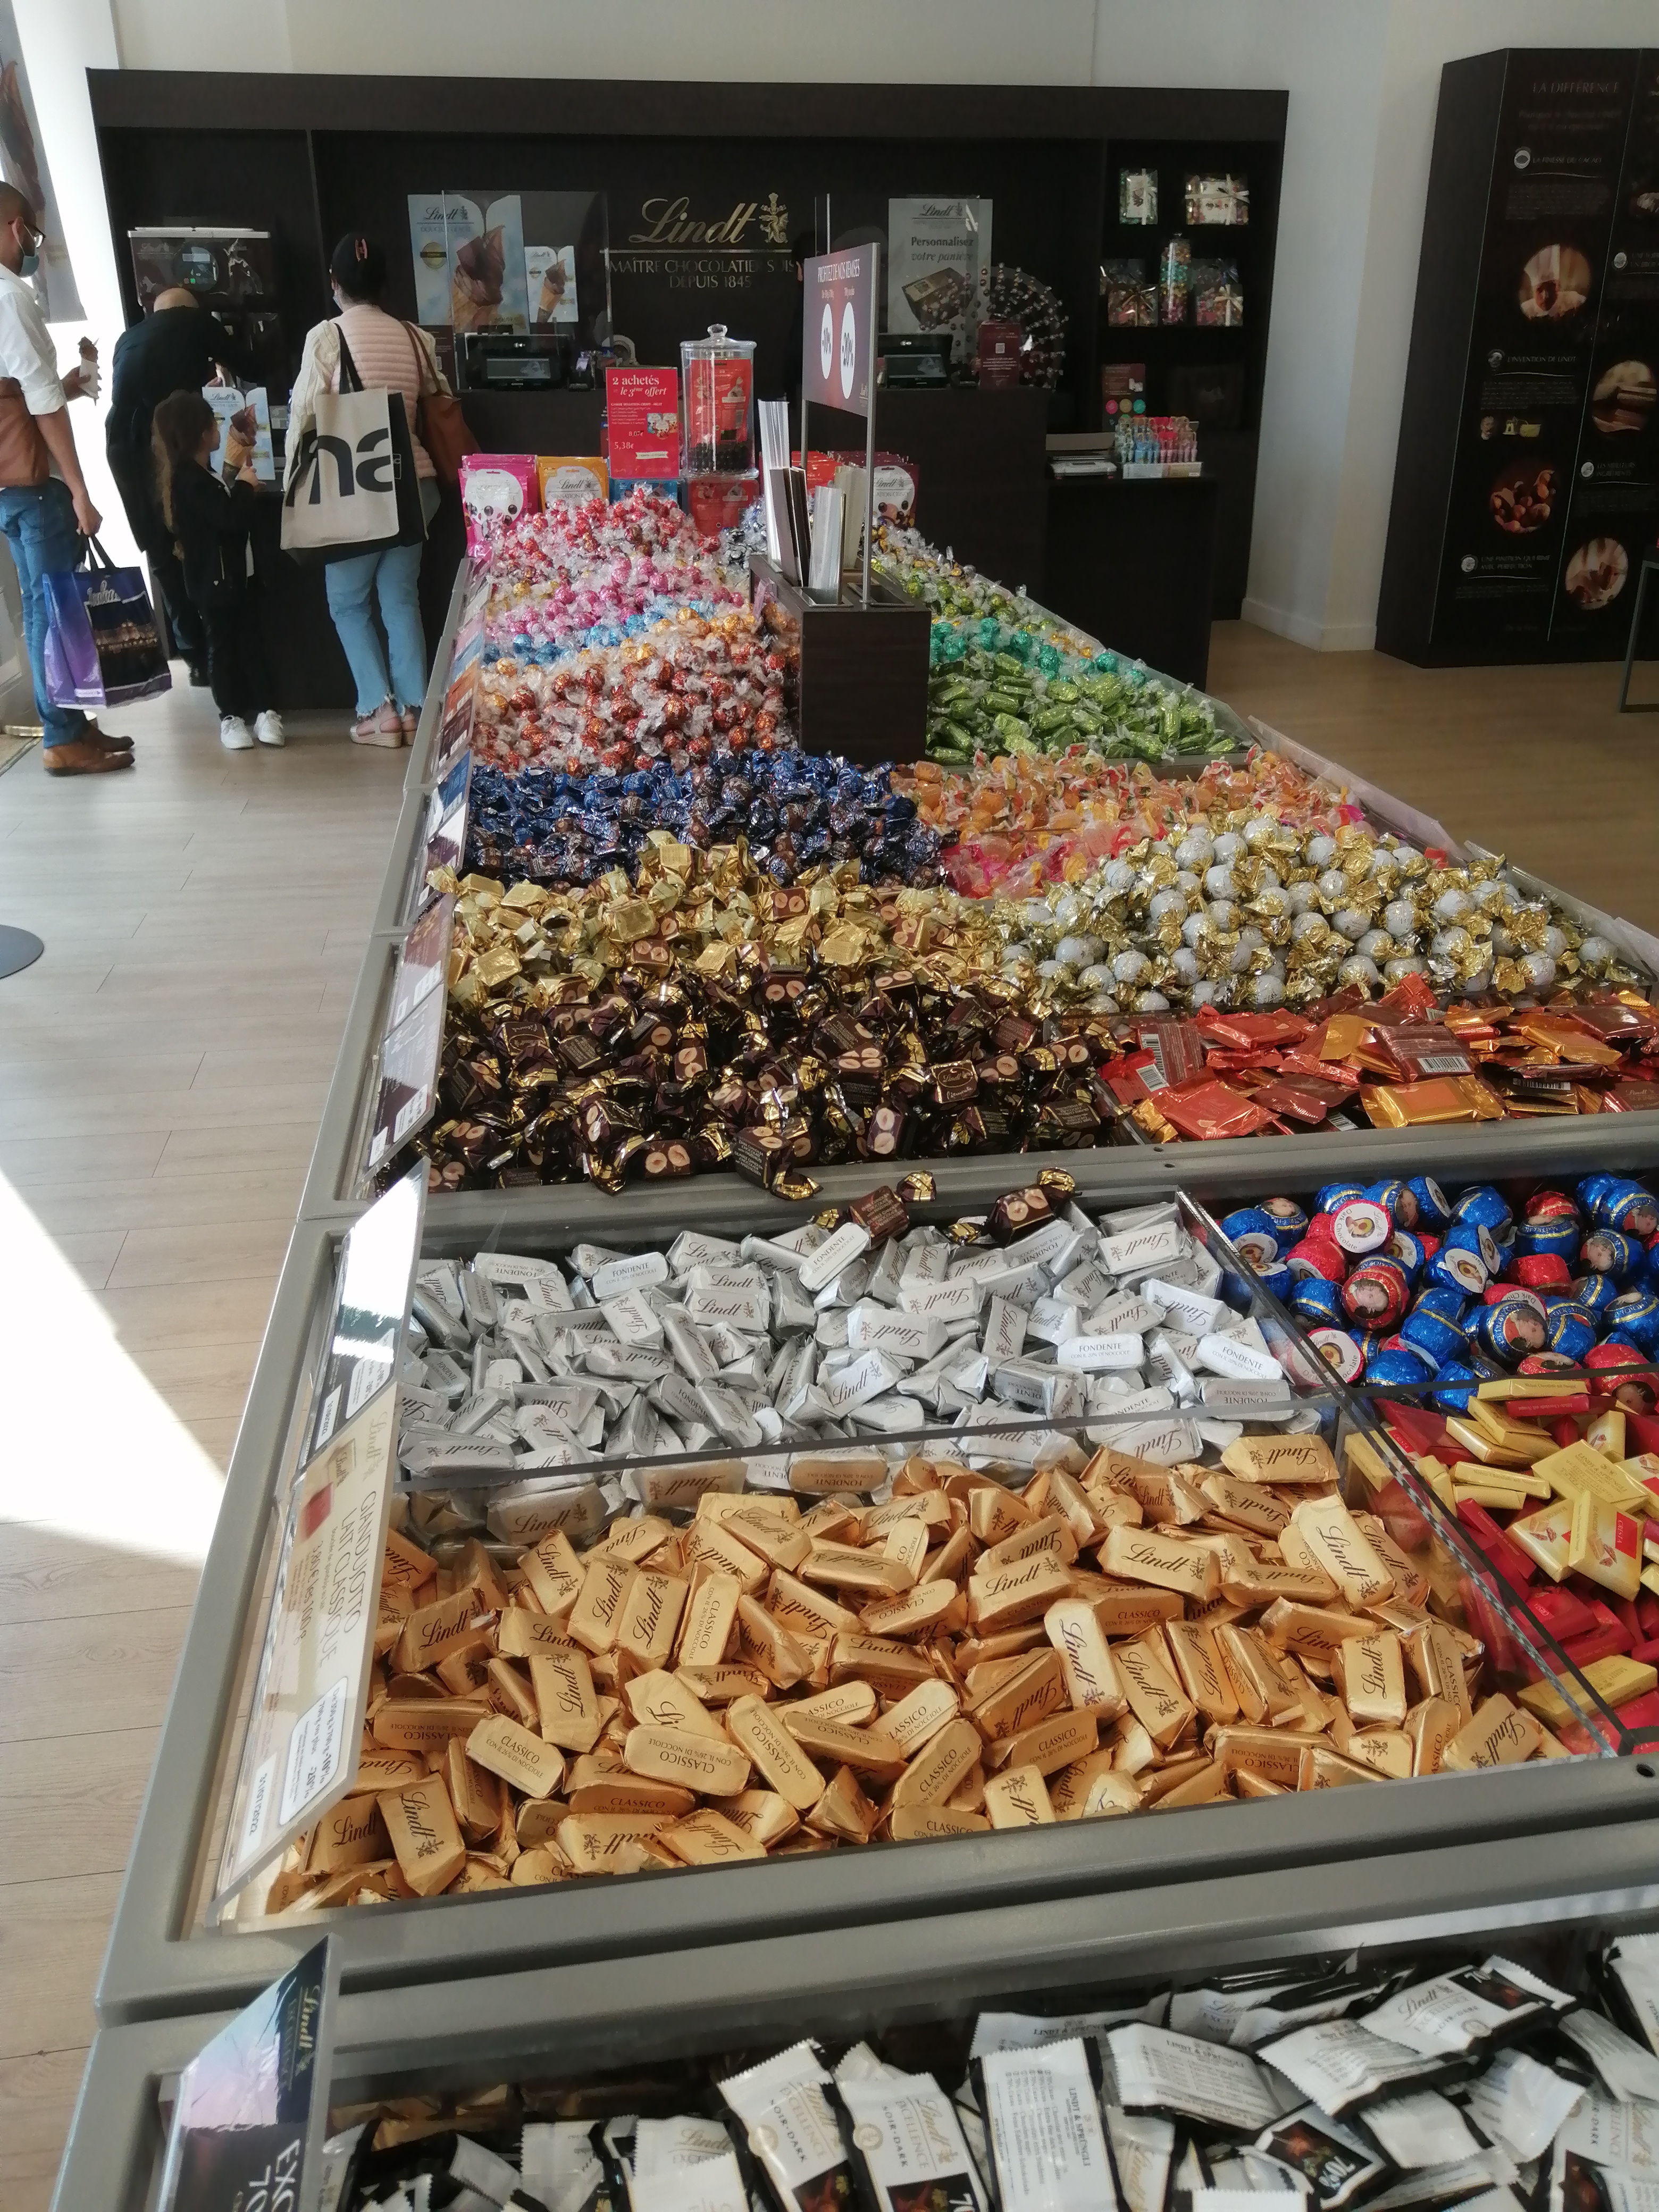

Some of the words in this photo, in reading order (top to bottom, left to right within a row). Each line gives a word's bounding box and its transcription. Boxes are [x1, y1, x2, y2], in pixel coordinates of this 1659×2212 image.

[1534, 82, 1547, 94] LA
[1551, 80, 1620, 94] DIFFÉRENCE
[424, 207, 458, 220] Lindt
[629, 197, 758, 243] Lindt
[919, 203, 954, 216] Lindt
[911, 237, 974, 246] Personnalisez
[665, 259, 763, 273] CHOCOLATIE
[911, 252, 936, 261] votre
[669, 275, 718, 288] DEPUIS
[724, 275, 751, 288] 1845
[833, 264, 837, 280] DE
[823, 327, 831, 354] -10%
[842, 332, 853, 367] -20%
[620, 387, 627, 395] le
[645, 388, 667, 397] offert
[622, 375, 659, 385] achetés
[1341, 1208, 1352, 1223] Dark
[813, 1235, 847, 1266] FONDENTE
[1336, 1224, 1358, 1251] Chocolate
[1022, 1242, 1059, 1263] FONDENTE
[613, 1262, 650, 1277] FONDENTE
[639, 1268, 657, 1279] NOCCIOLE
[1522, 1294, 1535, 1304] Dark
[1079, 1343, 1122, 1353] FONDENTE
[1222, 1346, 1264, 1371] FONDENTE
[1243, 1364, 1268, 1380] NOCCIOLE
[363, 1404, 389, 1470] Lindt
[1268, 1447, 1319, 1466] Lindt
[513, 1509, 572, 1535] Lindt
[743, 1507, 785, 1536] Lindt
[871, 1500, 917, 1524] Lindt
[337, 1506, 357, 1556] LAIT
[1019, 1527, 1062, 1560] Lindt
[307, 1538, 324, 1574] 3,80
[340, 1487, 377, 1640] GIANDUJOTTO
[535, 1543, 571, 1582] Lindt
[829, 1554, 891, 1571] Lindt
[1121, 1542, 1189, 1573] Lindt
[1316, 1524, 1369, 1581] Lindt
[307, 1566, 320, 1585] €
[985, 1563, 1041, 1598] Lindt
[1264, 1570, 1326, 1586] Lindt
[303, 1577, 319, 1605] les
[592, 1573, 624, 1628] Lindt
[298, 1598, 314, 1633] 100
[316, 1547, 351, 1672] CLASSIQUE
[633, 1586, 665, 1649] Lindt
[779, 1598, 838, 1640] Lindt
[879, 1598, 924, 1620] CLASSICO
[1118, 1609, 1160, 1620] CLASSICO
[292, 1627, 307, 1648] g
[419, 1608, 470, 1650] Lindt
[699, 1600, 720, 1649] CLASSICO
[850, 1637, 905, 1655] Lindt
[1059, 1619, 1097, 1689] Lindt
[713, 1670, 763, 1683] Lindt
[1117, 1650, 1168, 1702] Lindt
[1190, 1637, 1224, 1705] Lindt
[1363, 1647, 1388, 1699] Lindt
[331, 1687, 339, 1704] De
[560, 1665, 585, 1719] Lindt
[1012, 1674, 1058, 1731] Lindt
[316, 1699, 325, 1718] 700
[329, 1699, 338, 1719] 350
[314, 1723, 320, 1737] ou
[325, 1727, 333, 1747] 700
[818, 1725, 870, 1745] CLASSICO
[1038, 1727, 1077, 1753] CLASSICO
[309, 1733, 320, 1757] plus
[500, 1735, 540, 1764] CLASSICO
[751, 1727, 791, 1775] CLASSICO
[319, 1748, 332, 1785] -10%
[516, 1758, 544, 1778] NOCCIOLE
[659, 1750, 716, 1774] CLASSICO
[919, 1748, 958, 1792] CLASSICO
[304, 1762, 317, 1800] -20%
[249, 1771, 267, 1837] 31/07/2022
[399, 1791, 431, 1840] Lindt
[610, 1798, 666, 1808] CLASSICO
[687, 1820, 744, 1856] Lindt
[299, 1985, 320, 2048] Lindt
[1397, 1986, 1440, 2021] Lindt
[1413, 1996, 1471, 2033] EXCELLENCE
[1068, 2087, 1080, 2112] LINDT
[768, 2098, 789, 2129] NOIR
[789, 2132, 809, 2164] DARK
[779, 2086, 826, 2160] EXCELLENCE
[881, 2105, 898, 2132] NOIR
[895, 2139, 909, 2168] DARK
[894, 2099, 929, 2170] EXCELLENCE
[916, 2096, 950, 2152] Lindt
